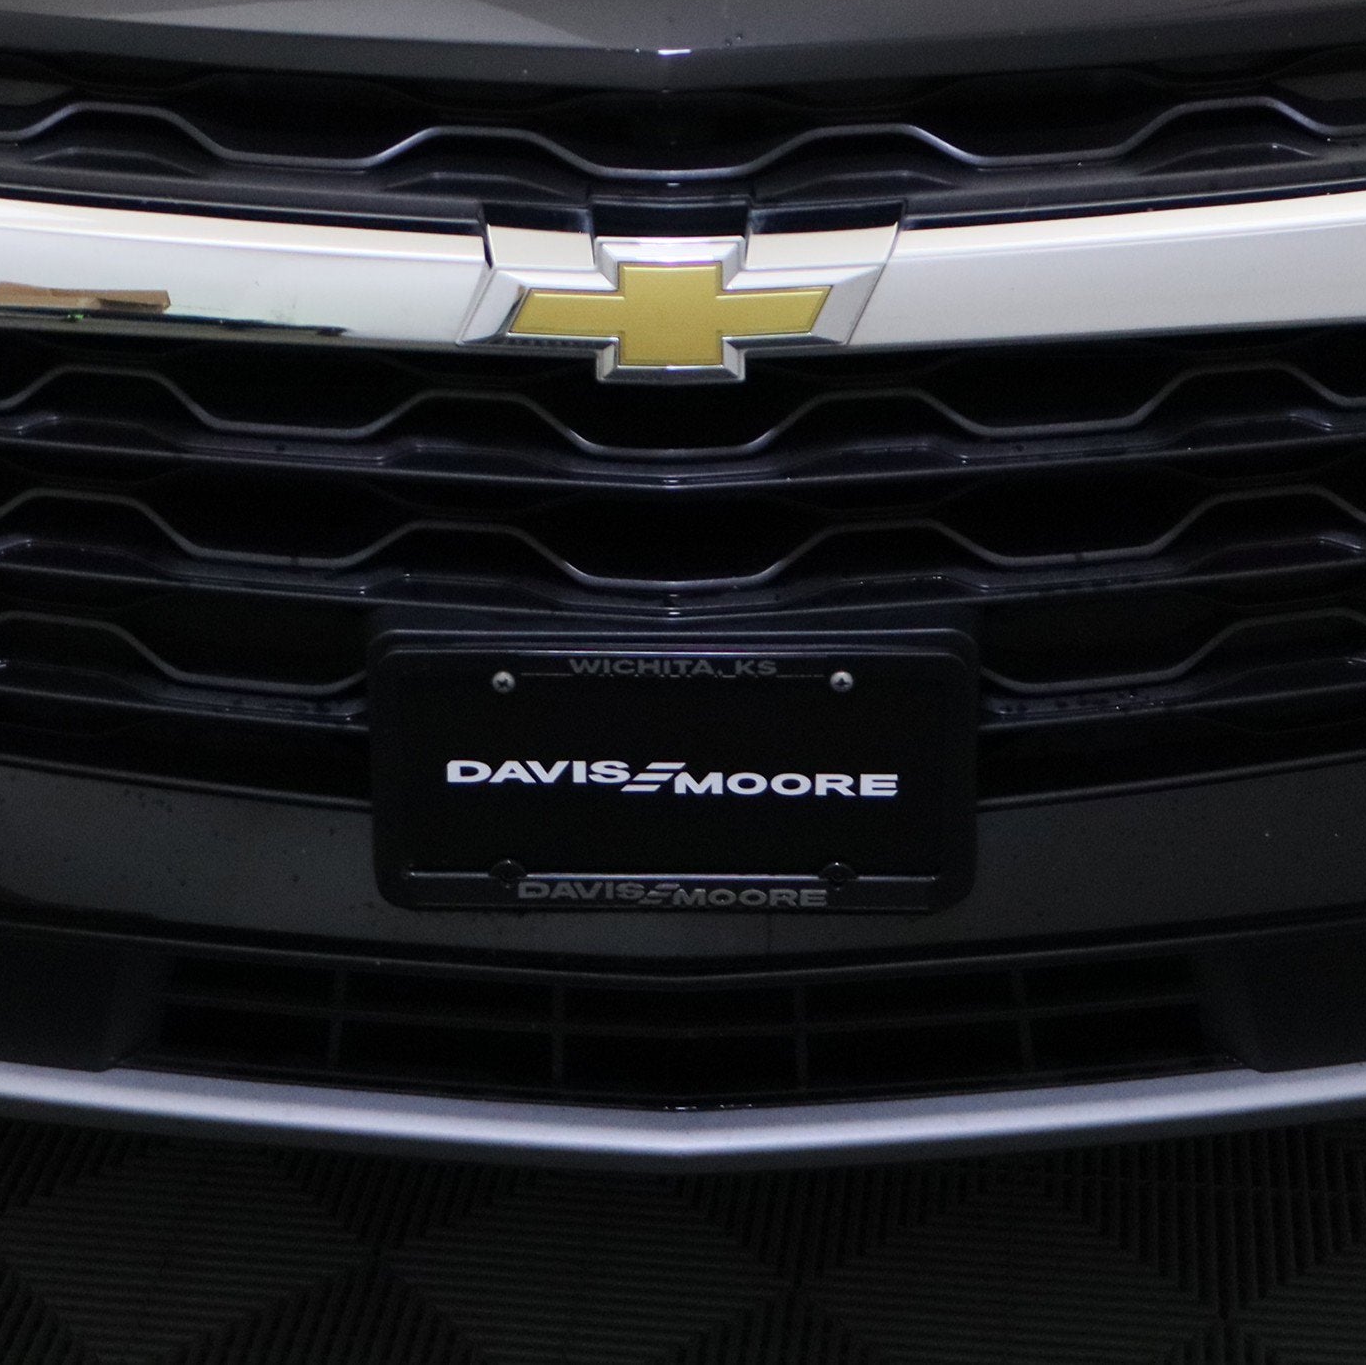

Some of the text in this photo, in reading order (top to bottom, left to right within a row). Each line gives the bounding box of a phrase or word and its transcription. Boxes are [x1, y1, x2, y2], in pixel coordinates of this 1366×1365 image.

[734, 659, 778, 677] KS
[446, 759, 899, 798] DAVIS MOORE
[517, 880, 829, 908] DAVIS MOORE
